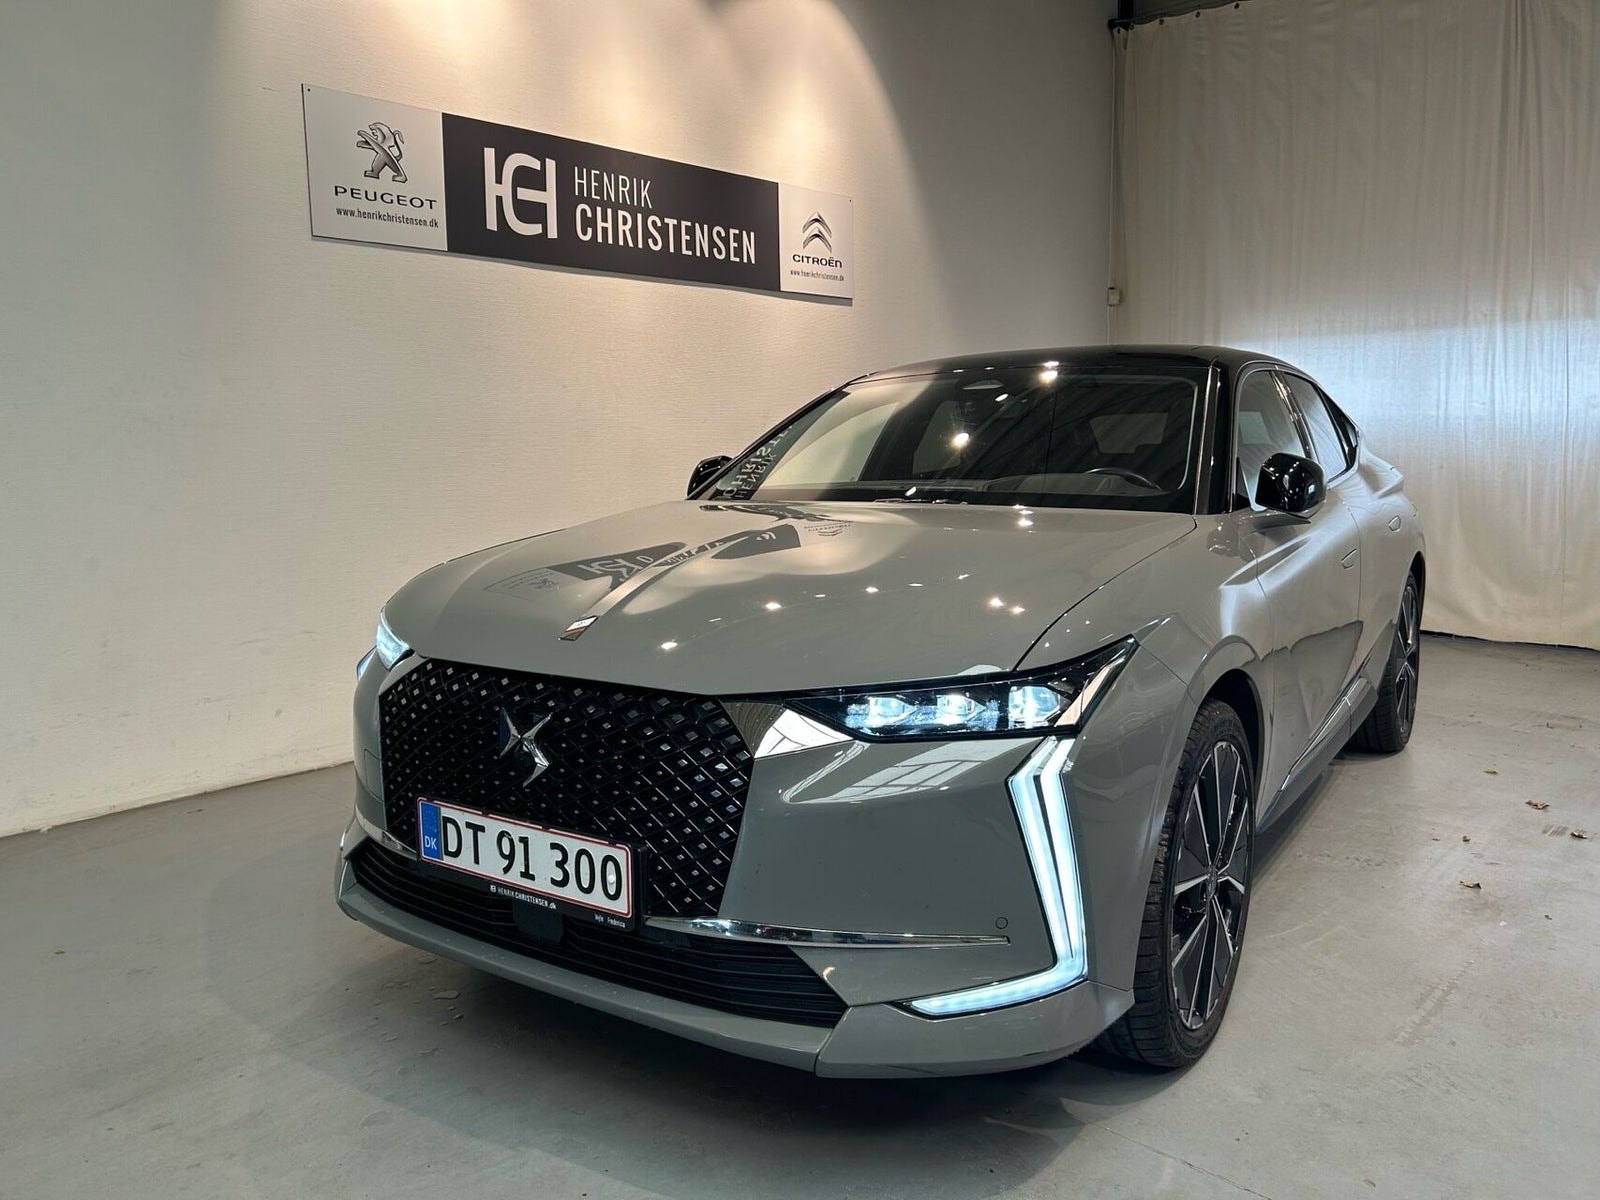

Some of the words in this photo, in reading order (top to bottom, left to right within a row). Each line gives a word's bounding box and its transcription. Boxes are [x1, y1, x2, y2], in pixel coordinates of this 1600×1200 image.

[334, 185, 437, 210] PEUGEOT
[574, 166, 653, 209] HENRIK
[335, 206, 439, 228] www.henrikchristensen.dk
[575, 203, 756, 265] CHRISTENSEN
[424, 835, 437, 850] DK
[441, 815, 485, 865] DT
[496, 829, 536, 882] 91
[549, 841, 623, 902] 300
